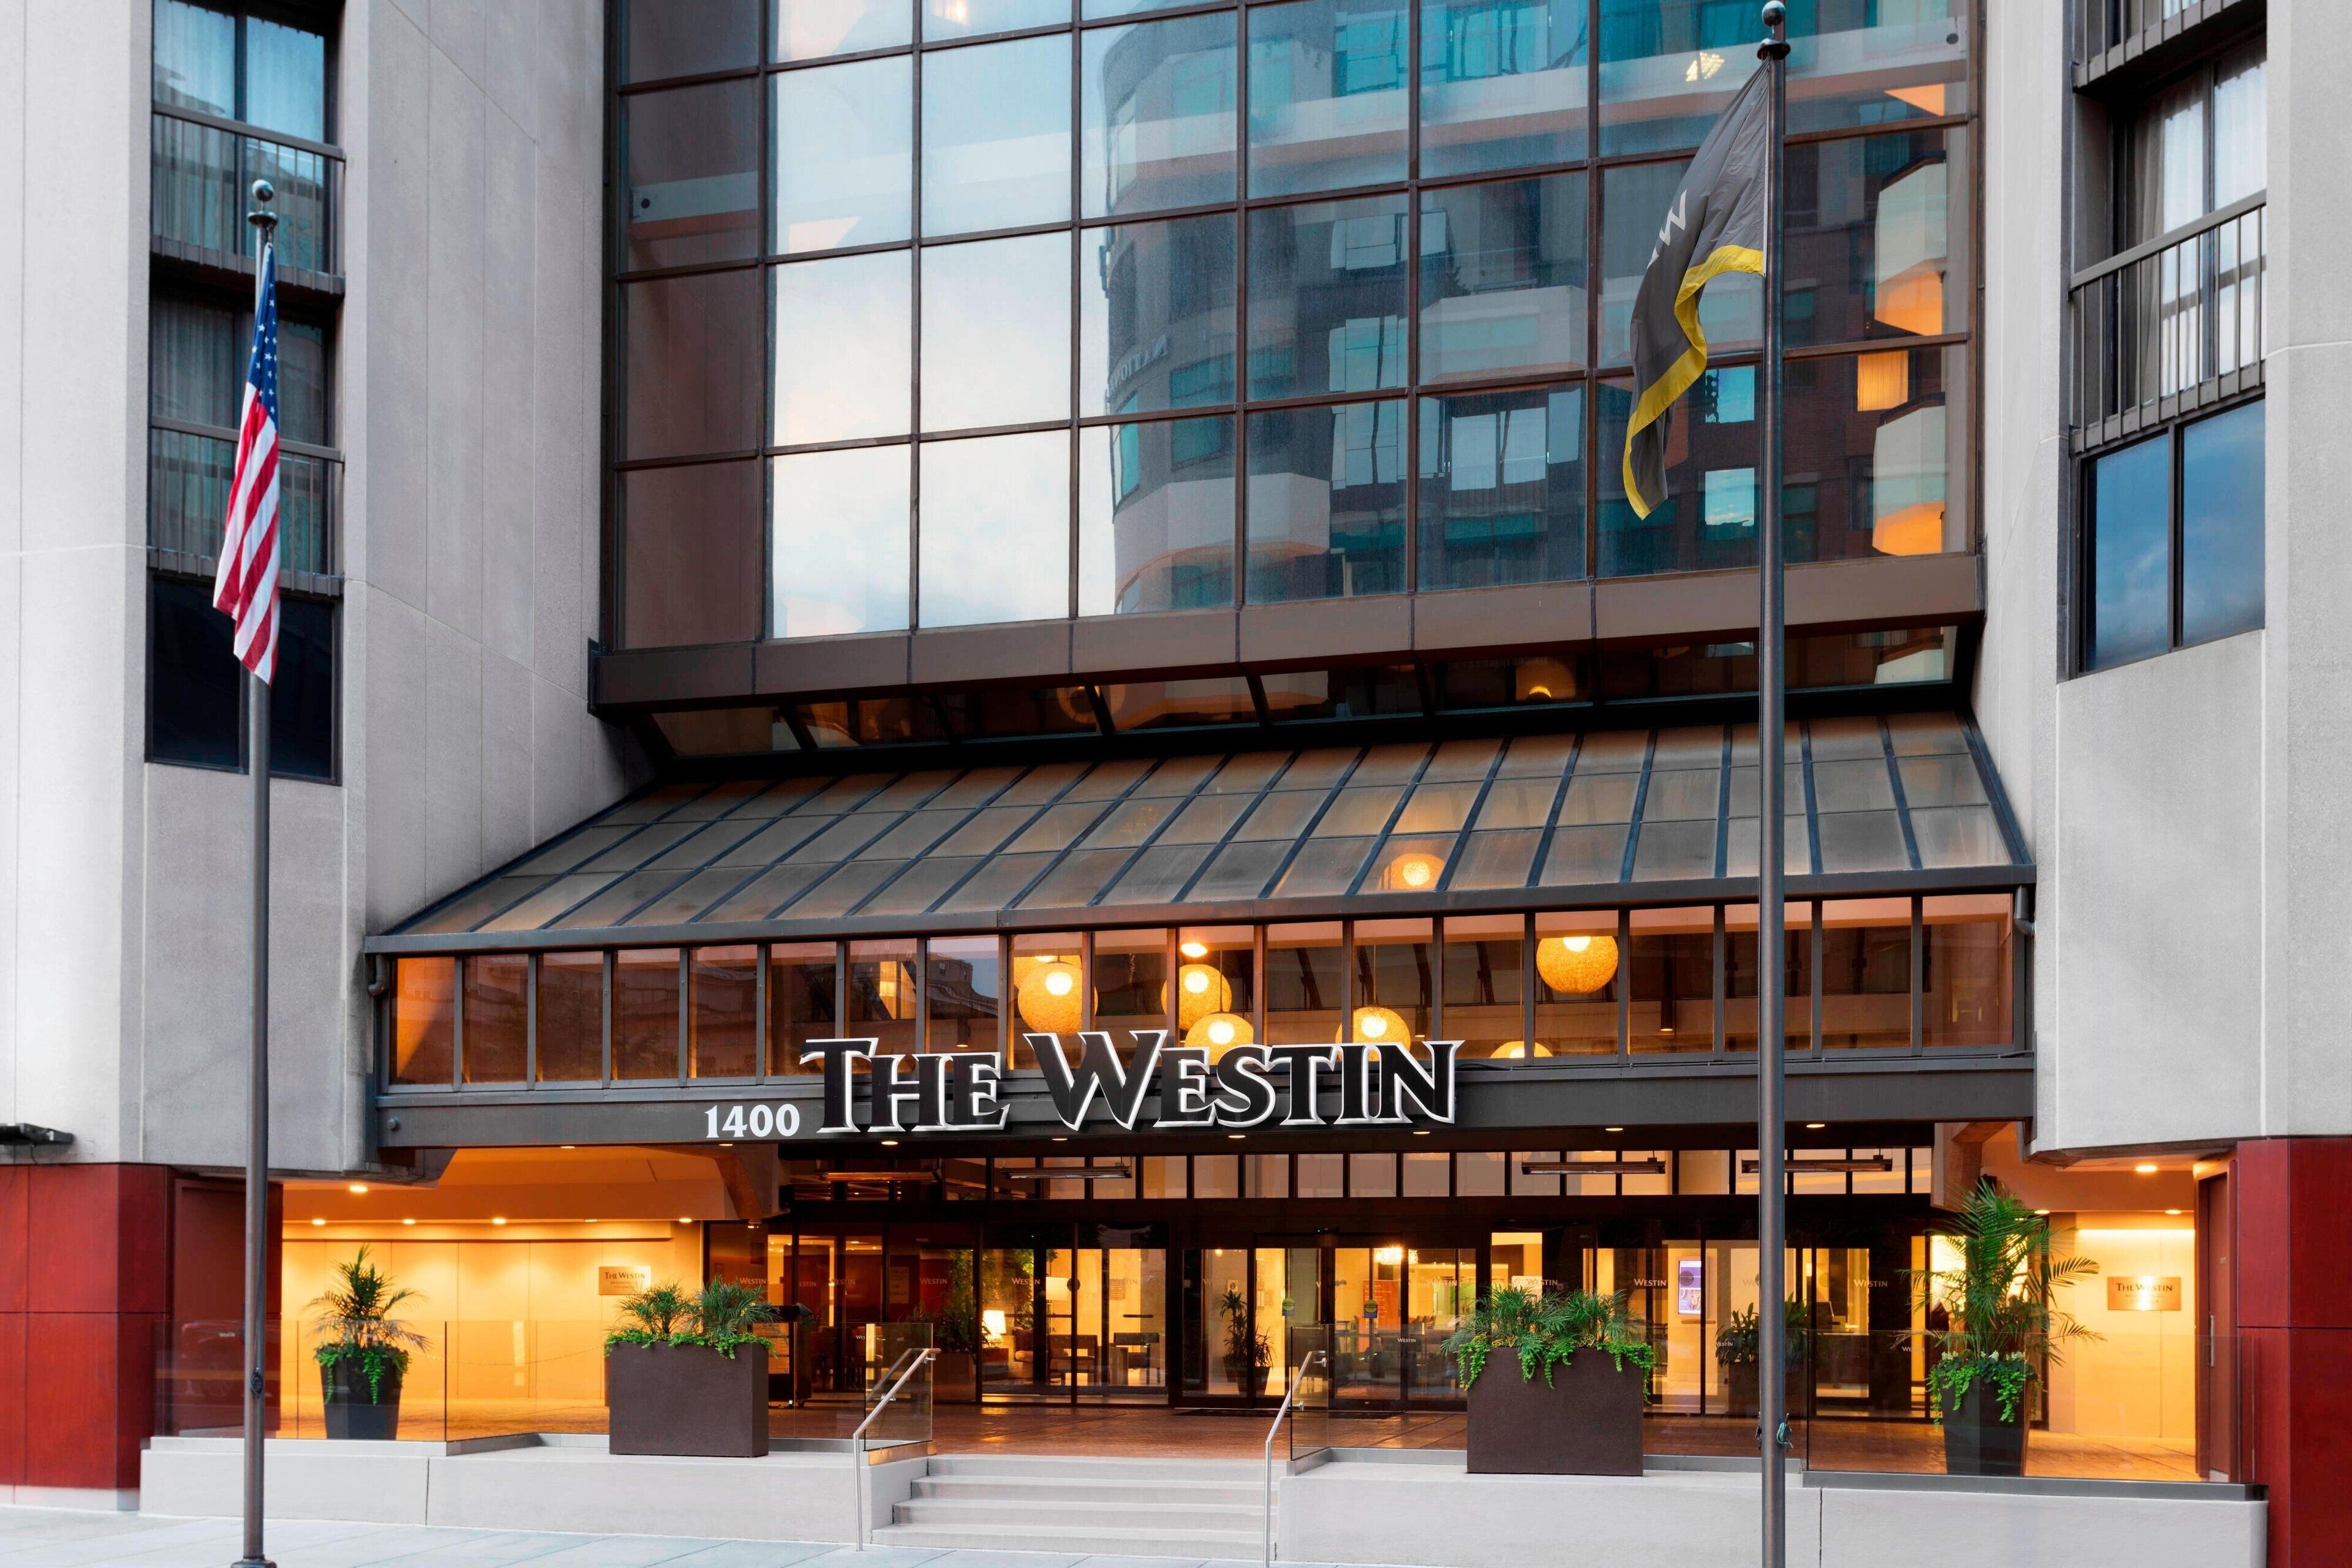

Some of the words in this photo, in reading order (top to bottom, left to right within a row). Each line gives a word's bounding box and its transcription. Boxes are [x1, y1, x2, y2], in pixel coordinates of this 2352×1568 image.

[799, 1037, 1011, 1133] THE
[1023, 1029, 1466, 1132] WESTIN
[704, 1103, 800, 1138] 1400
